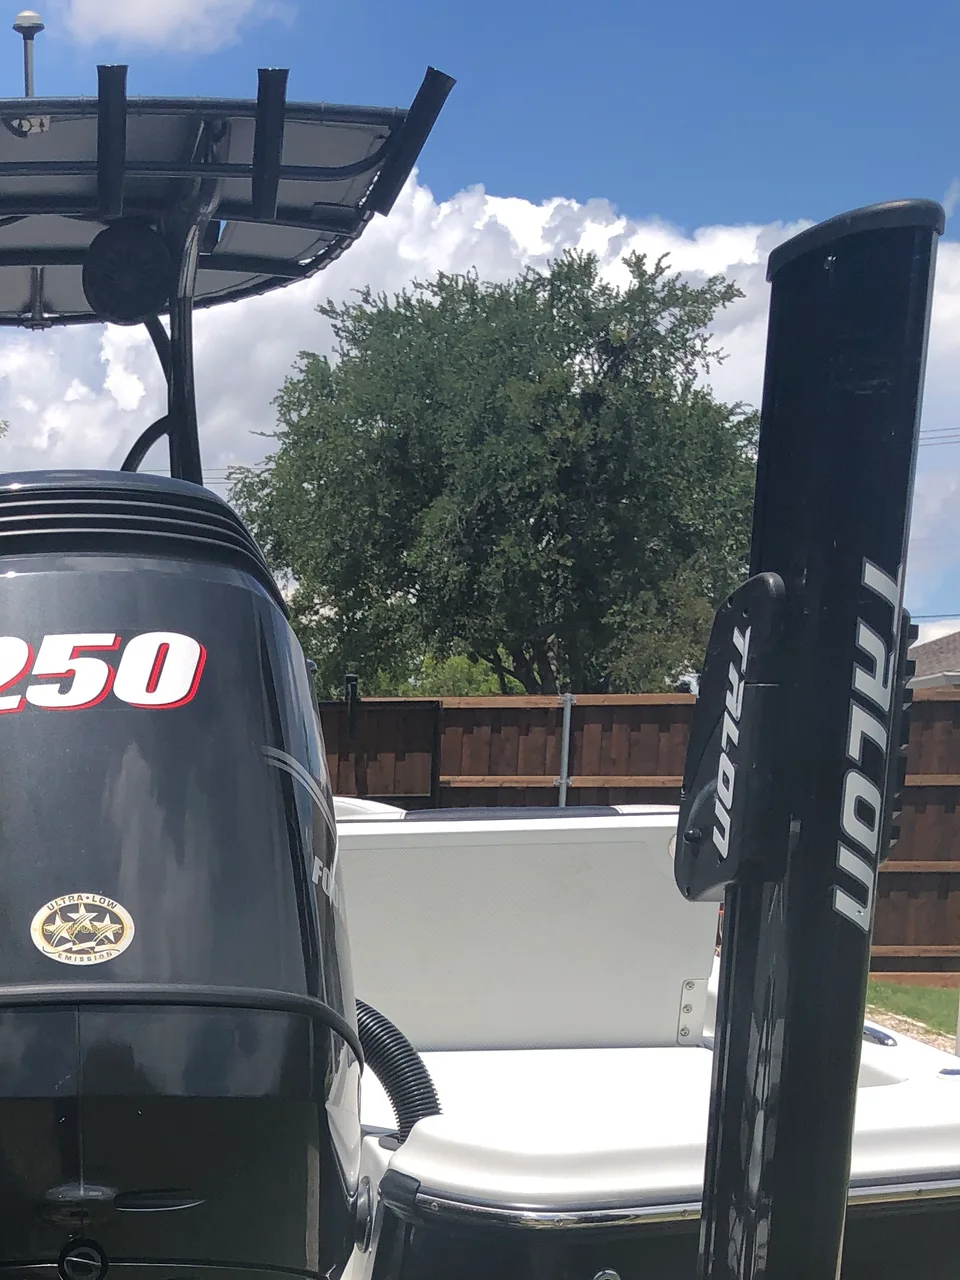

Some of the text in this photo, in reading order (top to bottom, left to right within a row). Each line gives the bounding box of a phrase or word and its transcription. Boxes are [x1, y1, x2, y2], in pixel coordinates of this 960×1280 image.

[713, 625, 751, 859] TALON
[833, 556, 904, 932] TALON
[46, 894, 118, 911] ULTRA LOW
[57, 952, 113, 962] EMISSION
